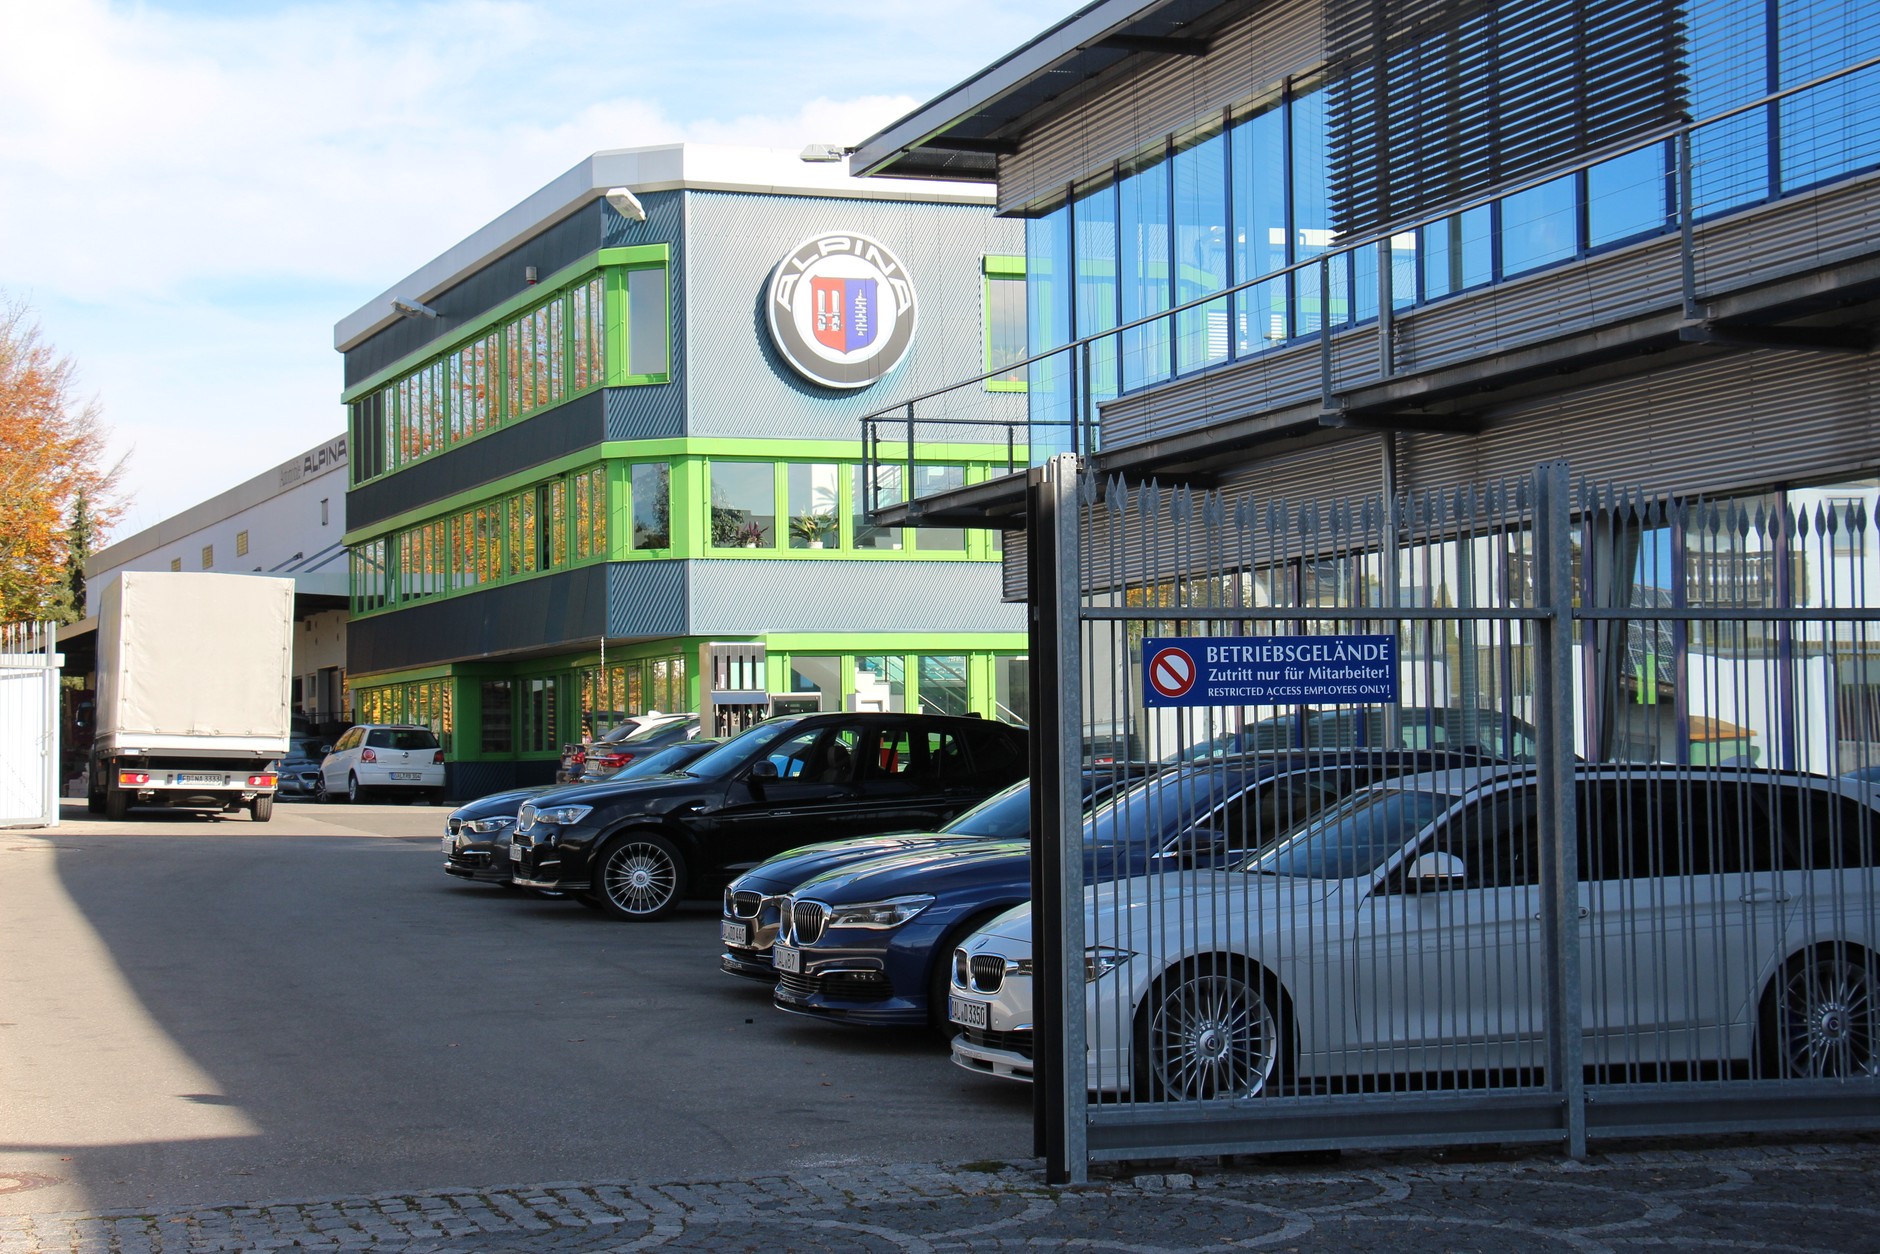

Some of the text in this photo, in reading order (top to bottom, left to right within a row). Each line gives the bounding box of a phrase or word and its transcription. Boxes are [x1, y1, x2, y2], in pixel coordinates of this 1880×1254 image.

[776, 237, 912, 317] ALPINA
[303, 439, 347, 476] ALPINA
[1207, 641, 1389, 663] BETRIEBSGELÄNDE
[1208, 665, 1390, 681] Zutritt nur für Mitarbeiter!
[1208, 684, 1390, 697] RESTRICTED ACCESS EMPLOYEES ONLY!
